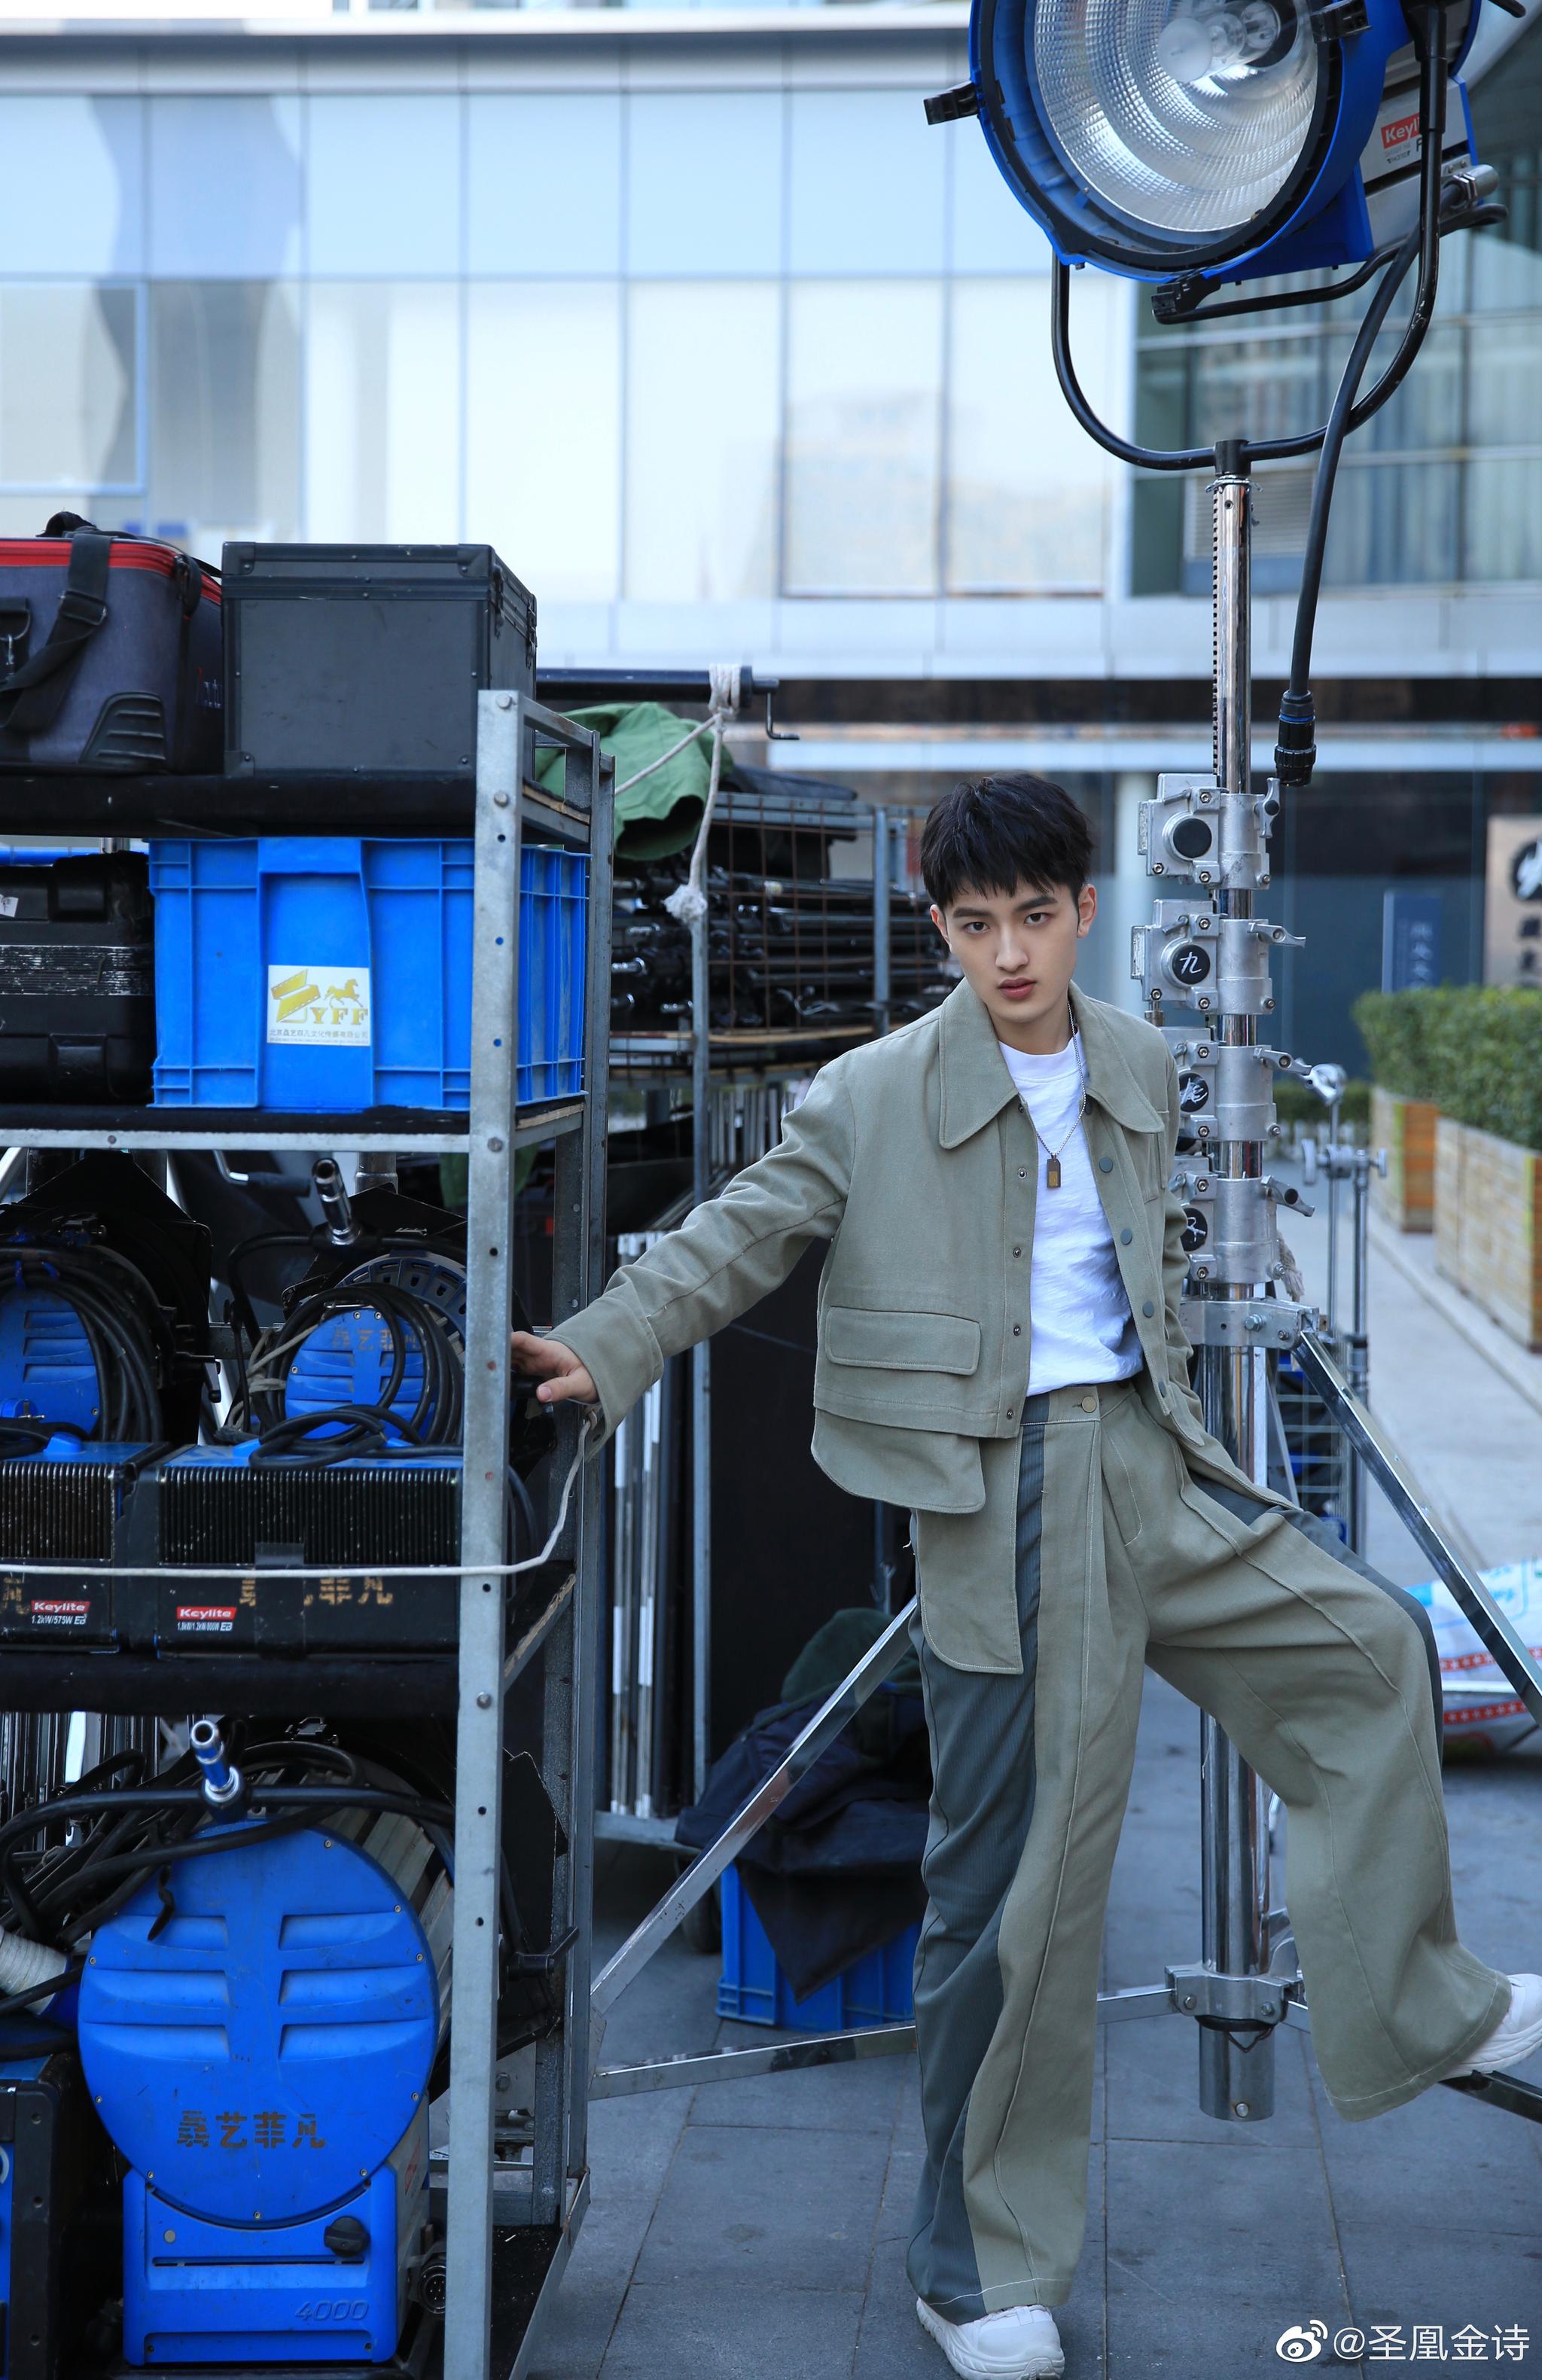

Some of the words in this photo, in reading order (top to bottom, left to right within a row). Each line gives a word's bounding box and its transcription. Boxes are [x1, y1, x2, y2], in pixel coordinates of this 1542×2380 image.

[34, 1601, 85, 1613] Keylite
[180, 1608, 232, 1620] Keylite
[294, 2300, 370, 2321] 4000
